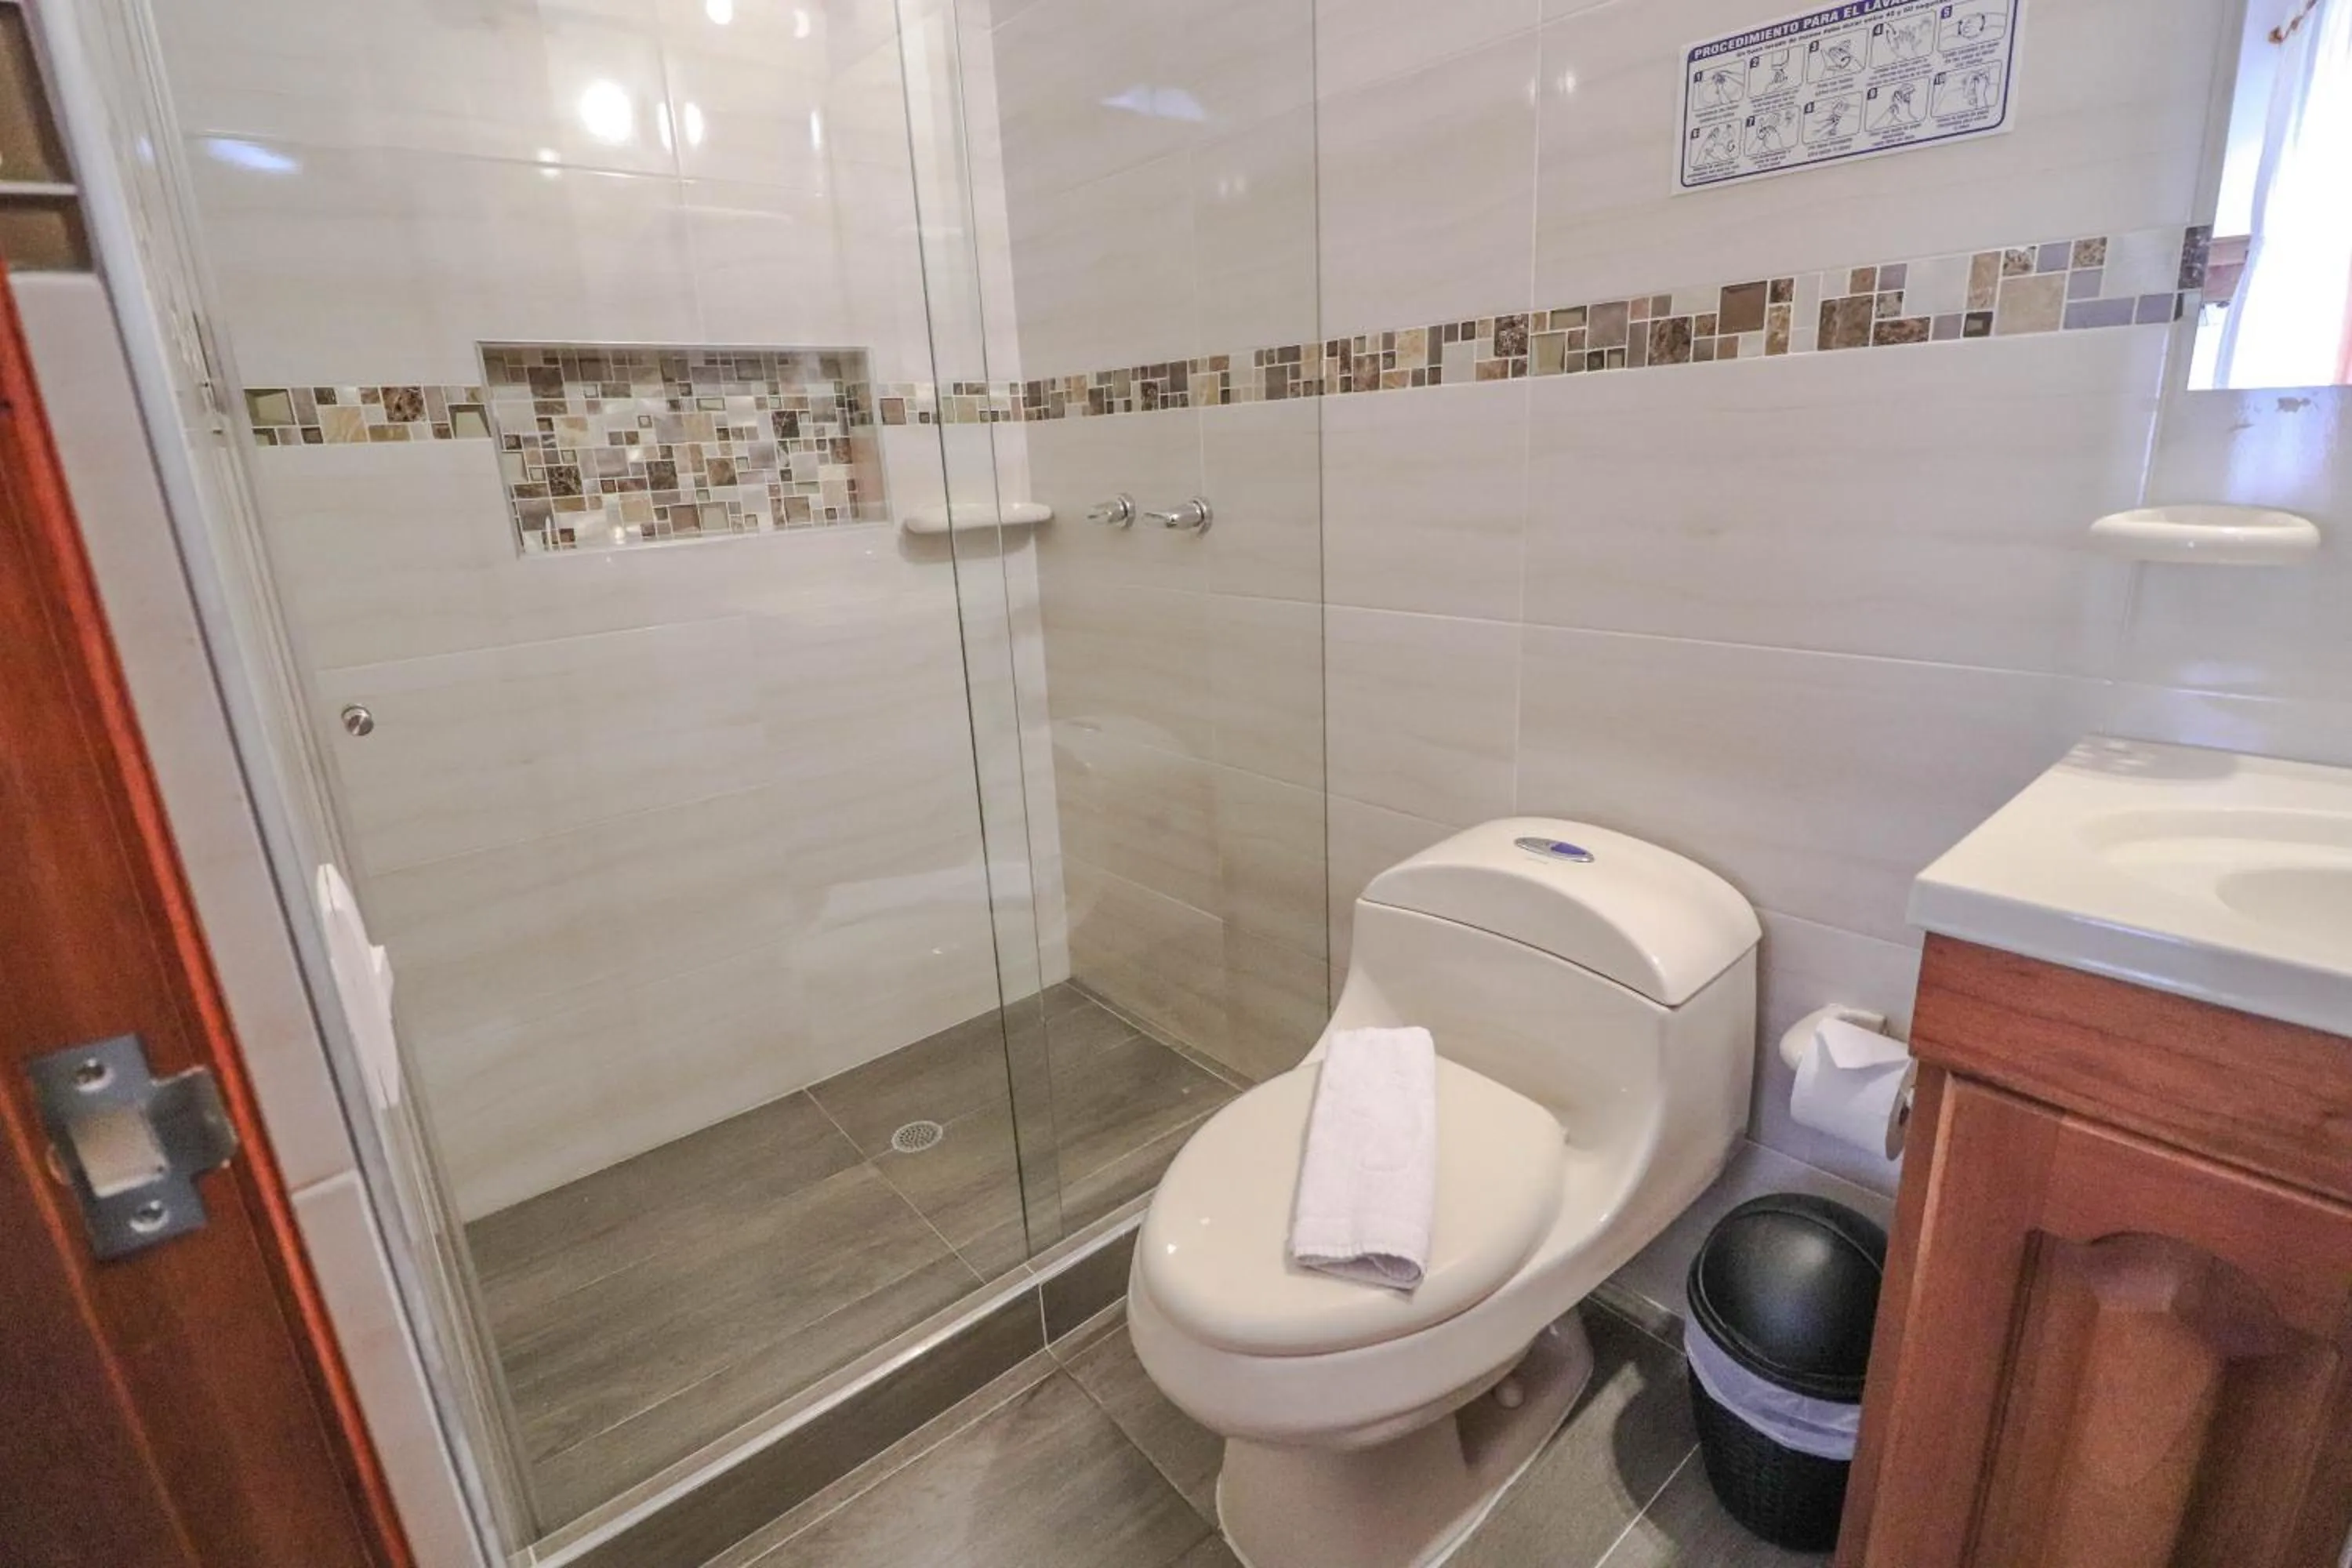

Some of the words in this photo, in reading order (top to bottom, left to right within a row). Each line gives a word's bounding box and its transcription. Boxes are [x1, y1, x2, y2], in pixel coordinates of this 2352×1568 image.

[1693, 20, 1798, 59] PROCEDIMIENTO
[1803, 9, 1838, 30] PARA
[1843, 5, 1860, 18] EL
